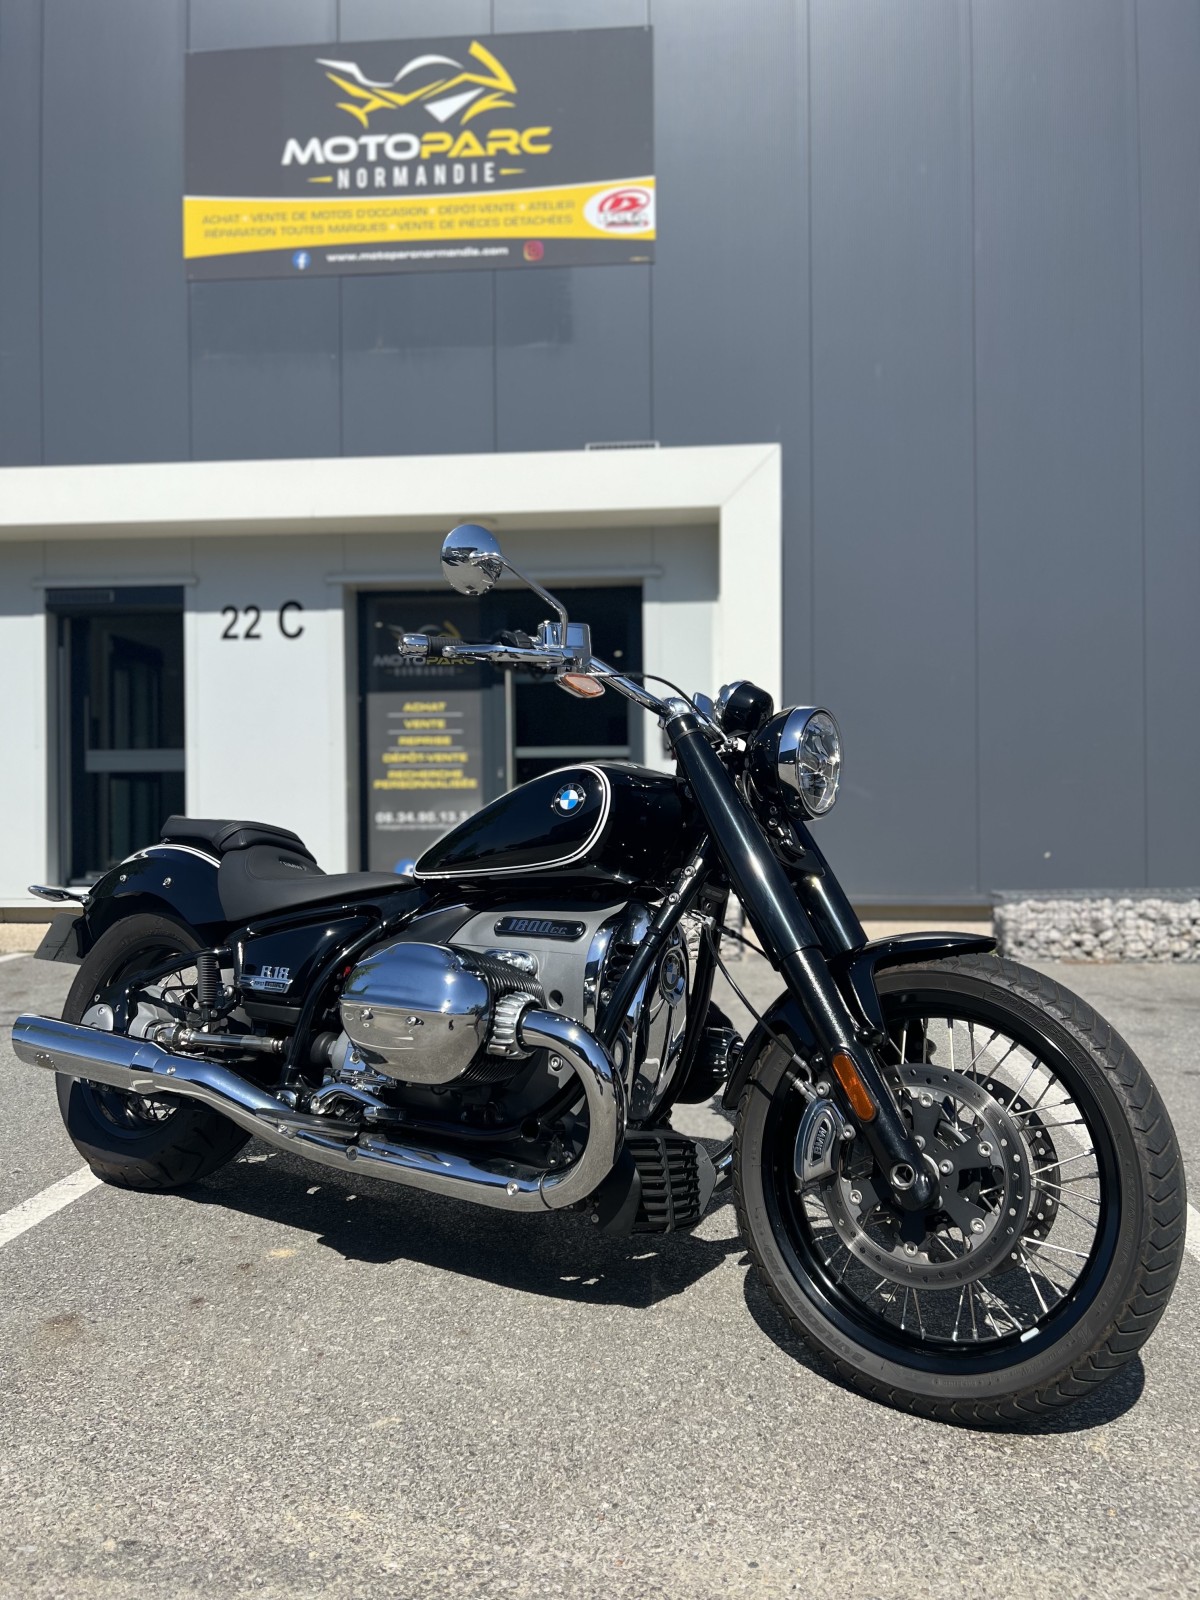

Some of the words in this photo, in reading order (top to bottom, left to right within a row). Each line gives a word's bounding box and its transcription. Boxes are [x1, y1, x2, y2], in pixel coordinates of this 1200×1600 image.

[281, 126, 552, 166] MOTOPARC
[337, 161, 495, 190] NORMANDIE
[201, 213, 240, 225] ACHAT
[250, 211, 288, 222] VENTE
[291, 210, 307, 221] DE
[311, 208, 353, 220] MOTOS
[356, 205, 429, 219] D'OCCASION
[528, 199, 576, 211] ATELIER
[280, 224, 324, 236] TOUTES
[327, 222, 387, 234] MARQUES
[397, 220, 435, 231] VENTE
[439, 218, 455, 229] DE
[325, 246, 509, 262] www.motoparcnormandie.com
[221, 604, 262, 641] 22
[279, 600, 304, 640] C
[508, 918, 567, 935] 1800cc
[813, 1126, 828, 1156] BMW
